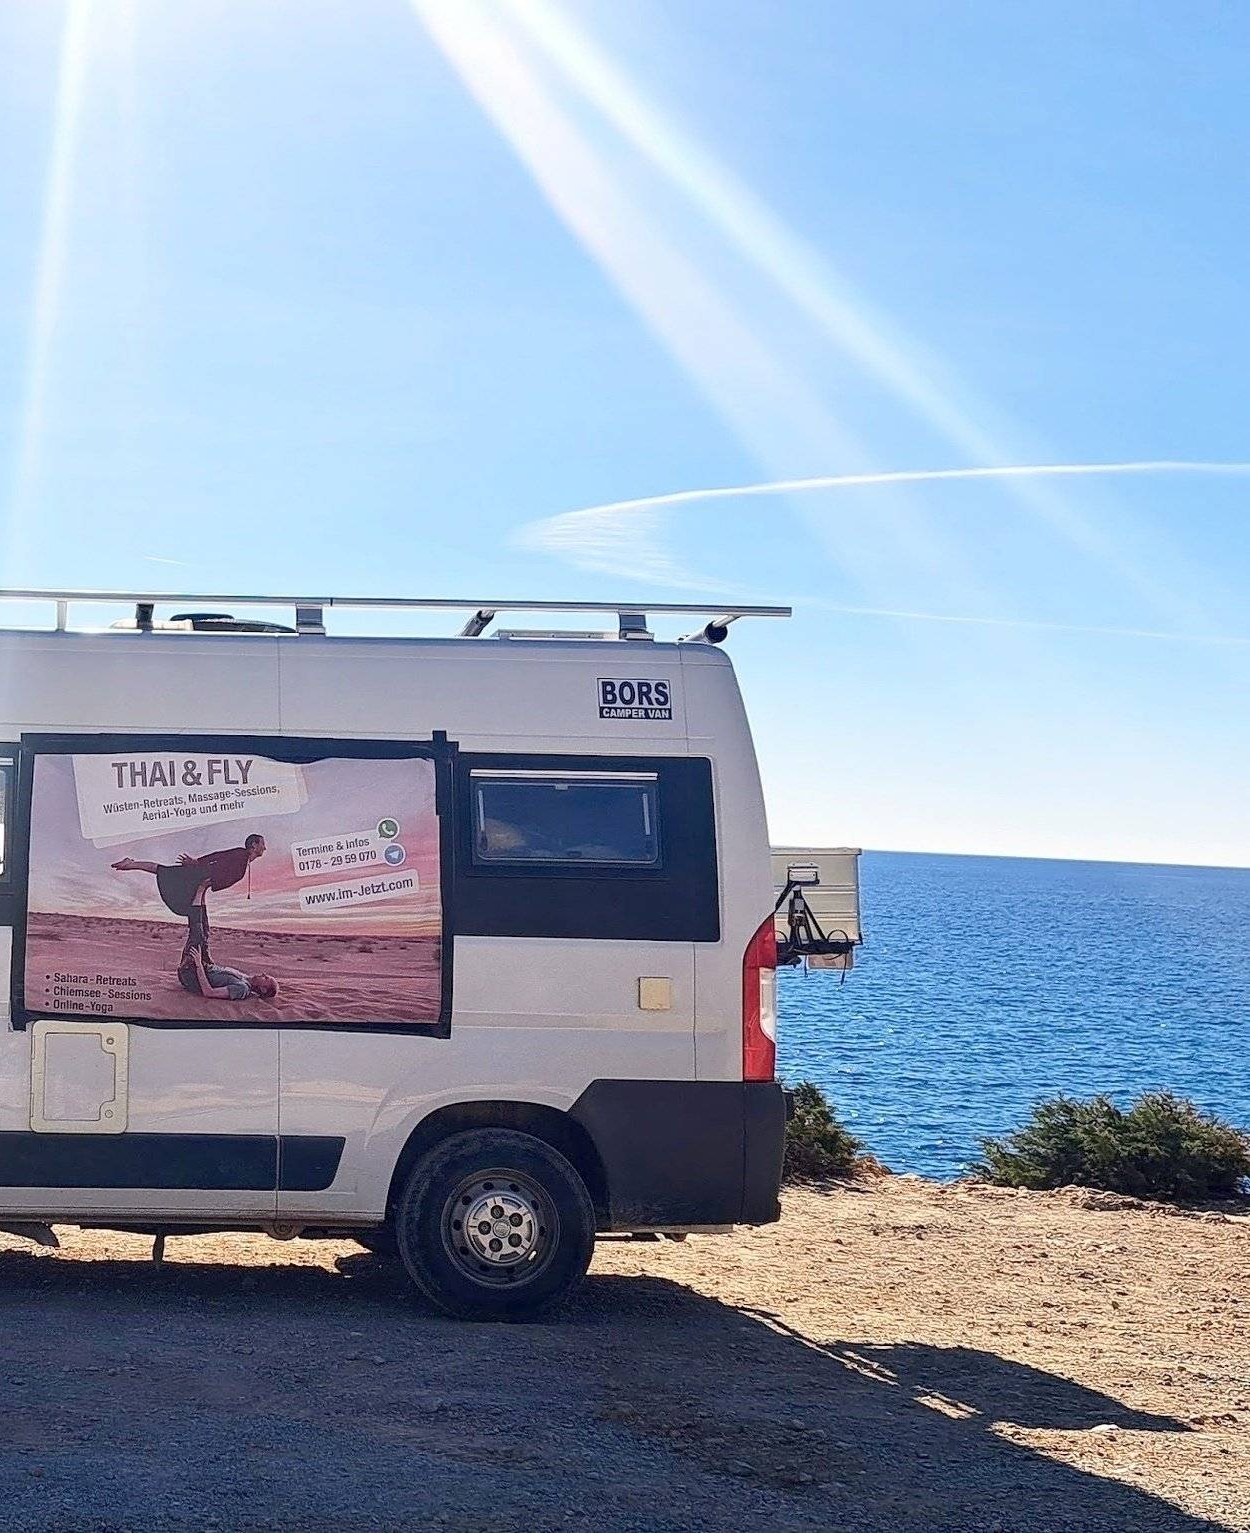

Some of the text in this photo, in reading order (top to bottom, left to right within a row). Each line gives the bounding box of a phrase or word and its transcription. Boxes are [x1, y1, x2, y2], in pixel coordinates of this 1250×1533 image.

[602, 681, 669, 706] BORS
[603, 708, 670, 719] CAMPER VAN
[111, 759, 254, 788] THAI & FLY
[103, 784, 281, 815] Wüsten-Retreats, Massage-Sessions,
[142, 799, 246, 822] Aerial-Yoga und mehr
[296, 838, 370, 857] Termine & Infos
[331, 856, 343, 867] 29
[344, 853, 357, 864] 59
[358, 850, 377, 862] 070
[305, 878, 414, 905] www.im-Jetzt.com
